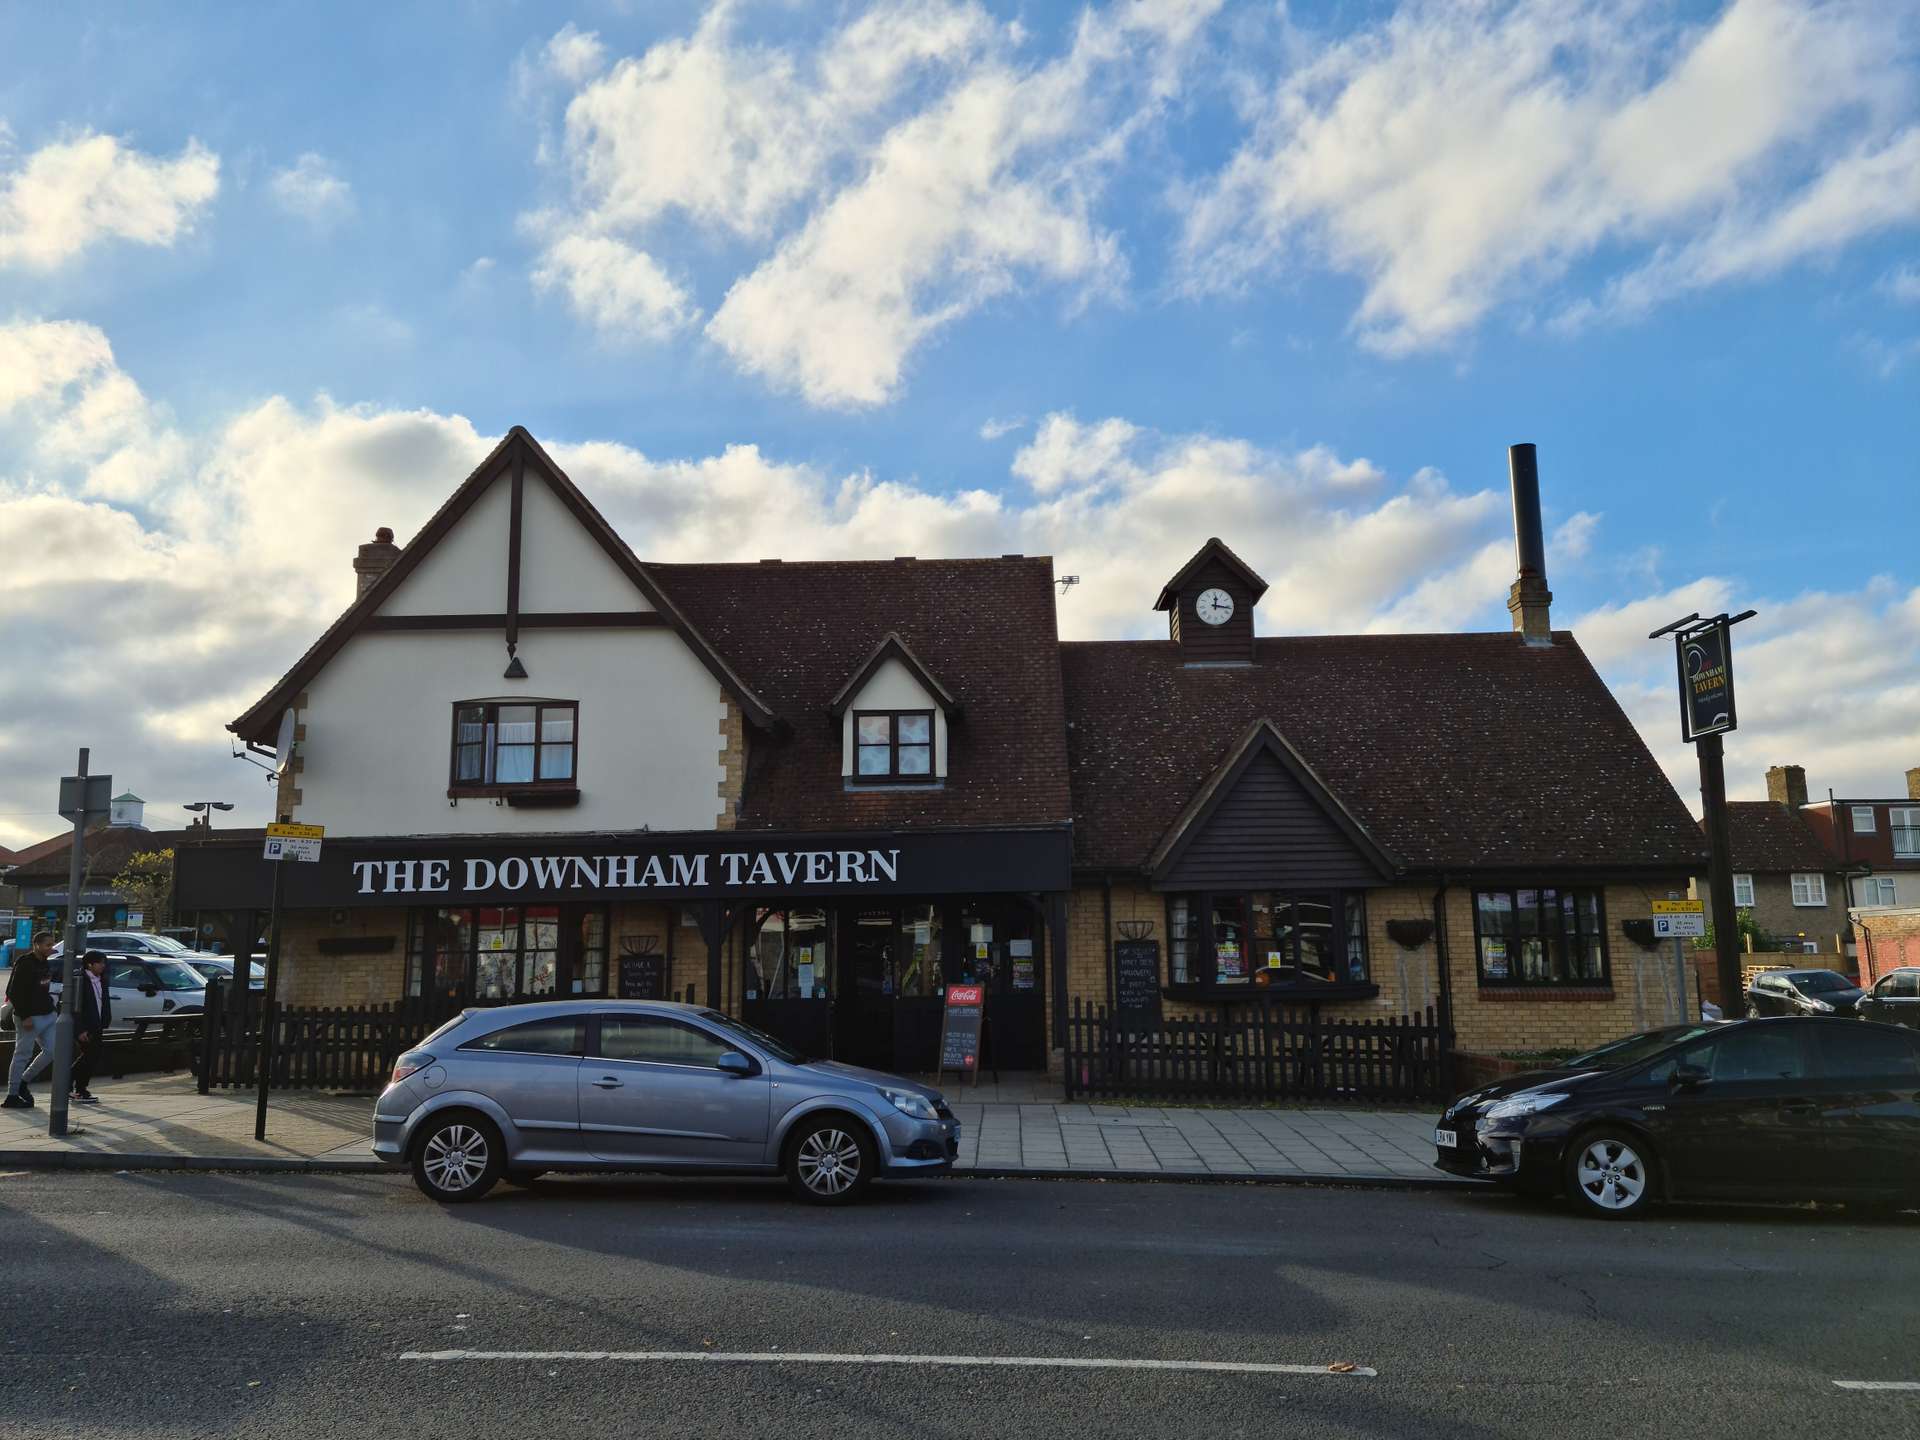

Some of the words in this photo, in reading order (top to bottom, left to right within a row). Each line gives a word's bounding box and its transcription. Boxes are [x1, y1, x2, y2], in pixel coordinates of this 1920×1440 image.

[1692, 665, 1724, 683] DOWNHAM
[1695, 674, 1725, 694] TAVERN
[353, 859, 450, 893] THE
[463, 854, 709, 891] DOWNHAM
[719, 850, 900, 885] TAVERN
